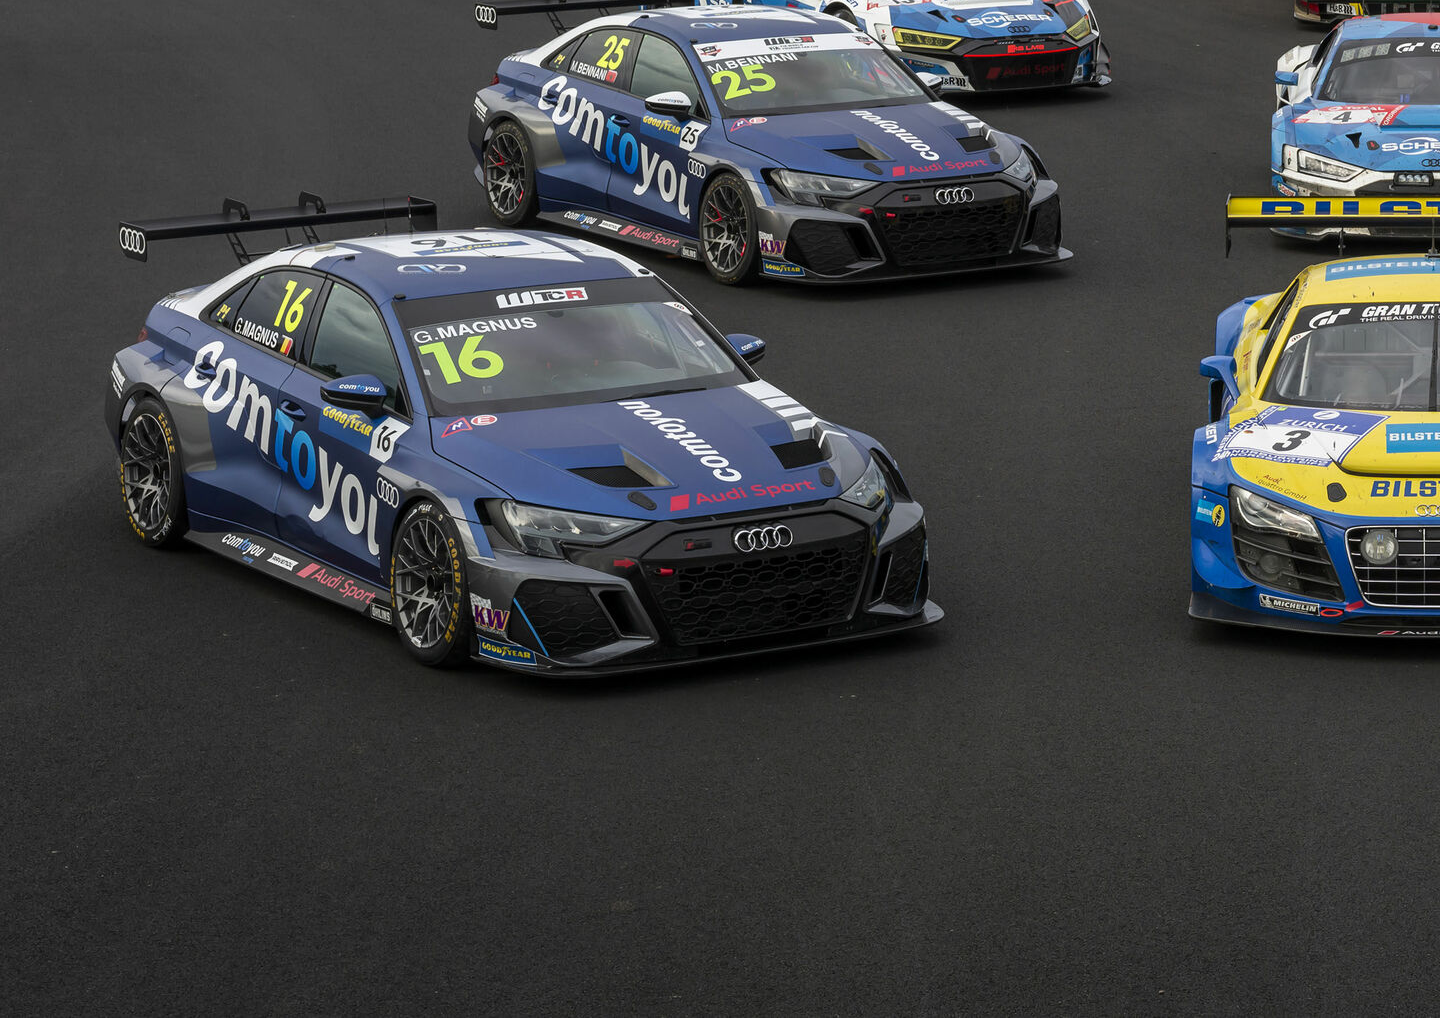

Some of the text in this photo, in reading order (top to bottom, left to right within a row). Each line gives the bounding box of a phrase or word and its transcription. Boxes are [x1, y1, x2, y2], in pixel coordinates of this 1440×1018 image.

[967, 11, 1052, 28] SCHERER
[596, 34, 631, 70] 25
[707, 52, 799, 74] M.BENNANI
[569, 60, 608, 82] M.BENNANI
[1002, 62, 1065, 78] Audi Sport
[711, 64, 776, 101] 25
[643, 115, 681, 135] GOODYEAR
[1332, 111, 1352, 123] 4
[681, 126, 699, 145] 25
[850, 110, 940, 162] comtoyou
[909, 158, 988, 174] Audi Sport
[564, 210, 598, 225] comtoyou
[630, 228, 680, 248] Audi Sport
[761, 239, 787, 256] KW
[765, 261, 801, 273] GOODYEAR
[1330, 261, 1436, 273] BILSTEIN
[273, 279, 313, 333] 16
[496, 286, 588, 309] WTCR
[1361, 304, 1416, 318] GRAN
[234, 317, 280, 349] G.MAGNUS
[414, 316, 537, 344] G.MAGNUS
[418, 335, 505, 385] 16
[338, 383, 380, 393] comtoyou
[322, 405, 374, 437] GOODYEAR
[1277, 419, 1348, 432] ZURICH
[157, 412, 176, 455] EAGLE
[376, 425, 397, 453] 16
[617, 399, 743, 483] comtoyou
[1272, 430, 1311, 452] 3
[1258, 479, 1308, 501] quattro GmbH
[1262, 474, 1280, 484] Audi
[696, 480, 817, 507] Audi Sport
[222, 533, 266, 557] comtoyou
[312, 568, 343, 589] Audi
[338, 577, 375, 605] Sport
[1273, 599, 1317, 612] MICHELIN
[474, 604, 510, 631] KW
[482, 642, 531, 659] GOODYEAR
